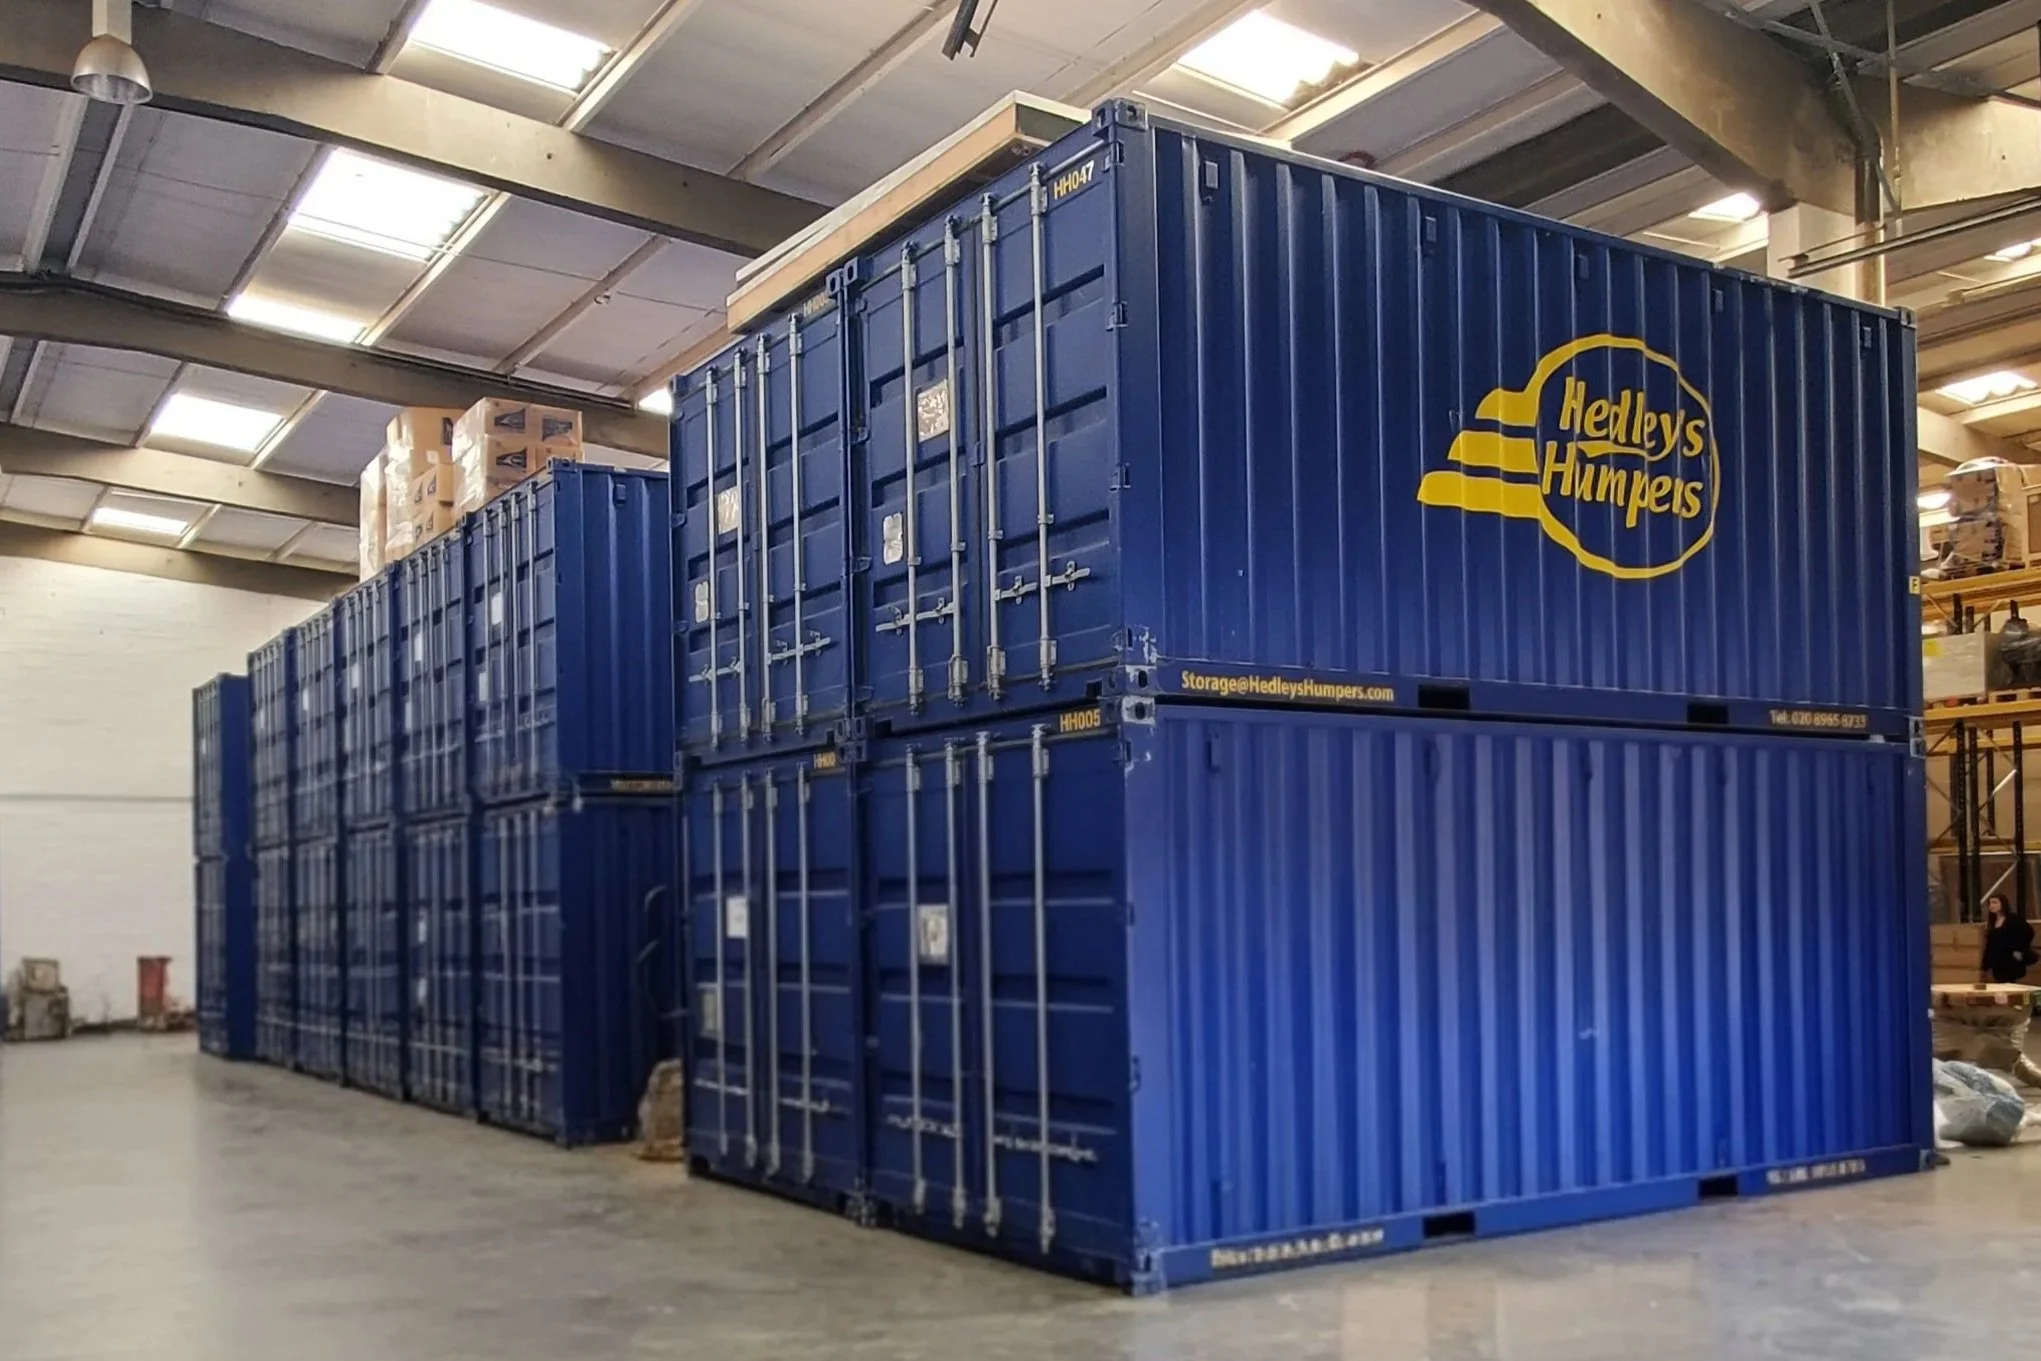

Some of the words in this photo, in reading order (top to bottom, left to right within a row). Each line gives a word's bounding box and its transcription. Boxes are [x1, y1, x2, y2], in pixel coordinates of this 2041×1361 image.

[1053, 160, 1095, 200] HH047
[1559, 376, 1705, 461] Hedley's
[1542, 440, 1704, 528] Humpers
[1181, 670, 1394, 702] Storage@HedleysHumpers.com
[1059, 708, 1101, 732] HH005
[1792, 711, 1811, 726] 020
